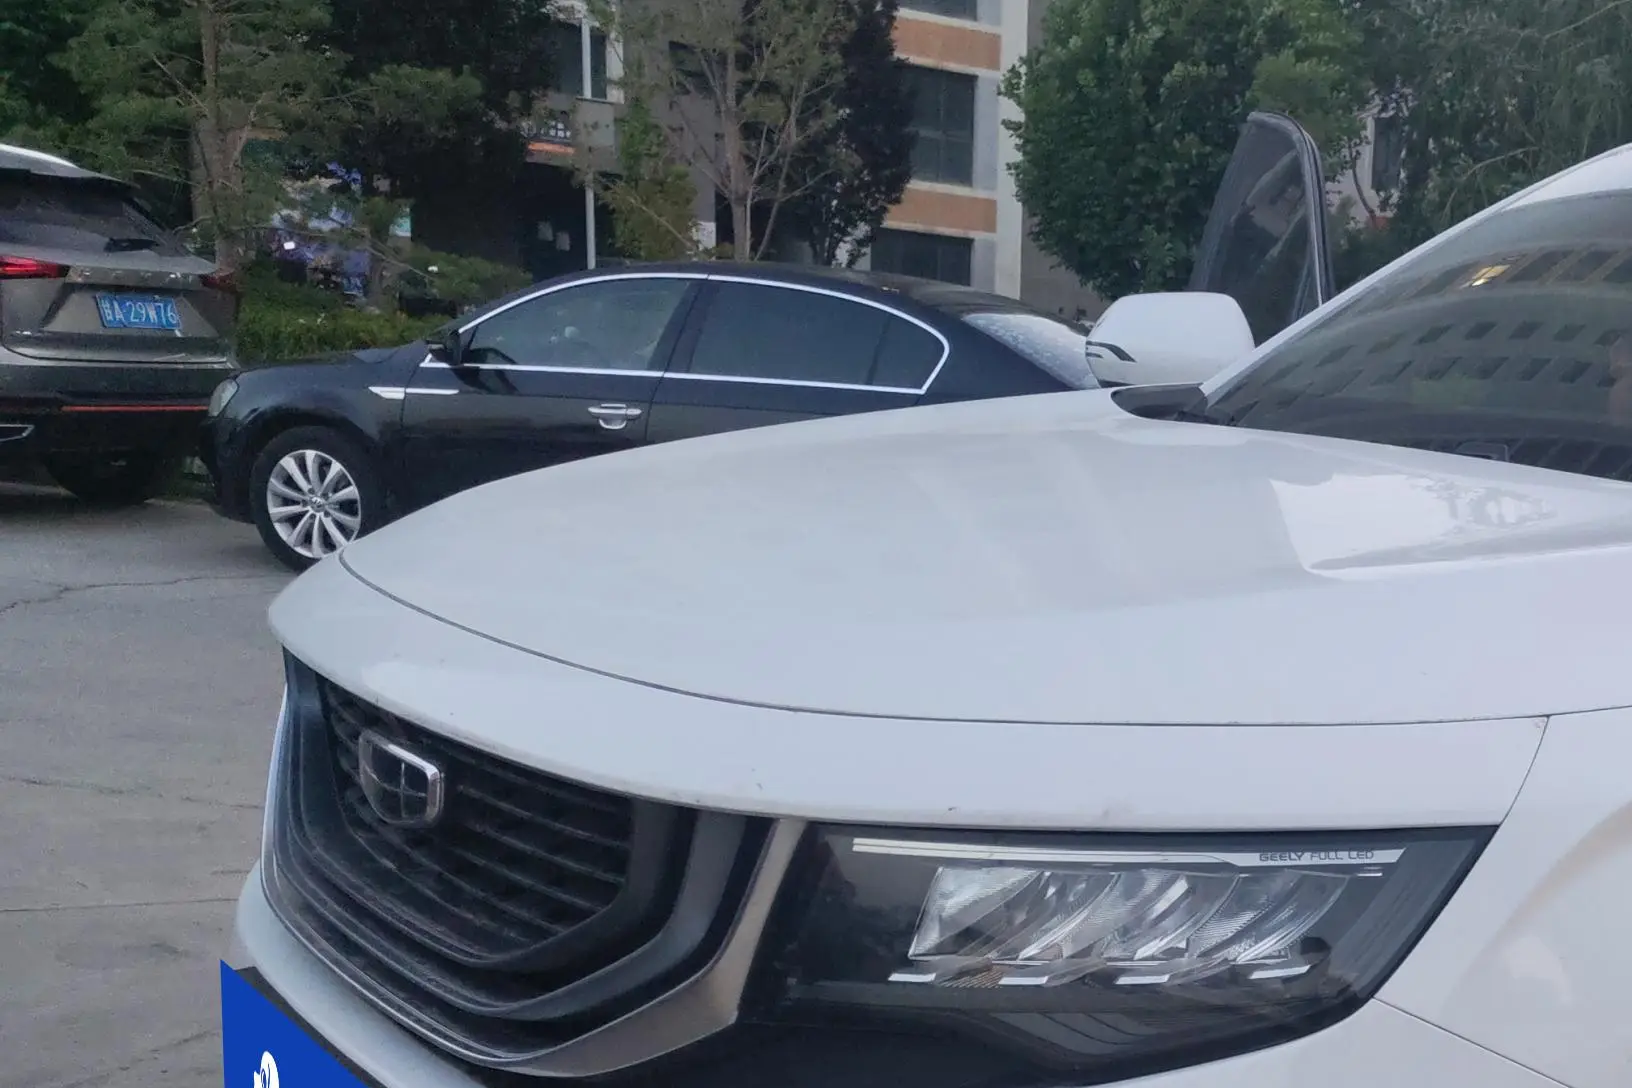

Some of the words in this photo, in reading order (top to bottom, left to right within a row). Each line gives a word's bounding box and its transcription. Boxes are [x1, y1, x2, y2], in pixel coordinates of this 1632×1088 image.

[1258, 850, 1306, 862] GEELY
[1310, 850, 1344, 861] FULL
[1347, 850, 1375, 860] LED
